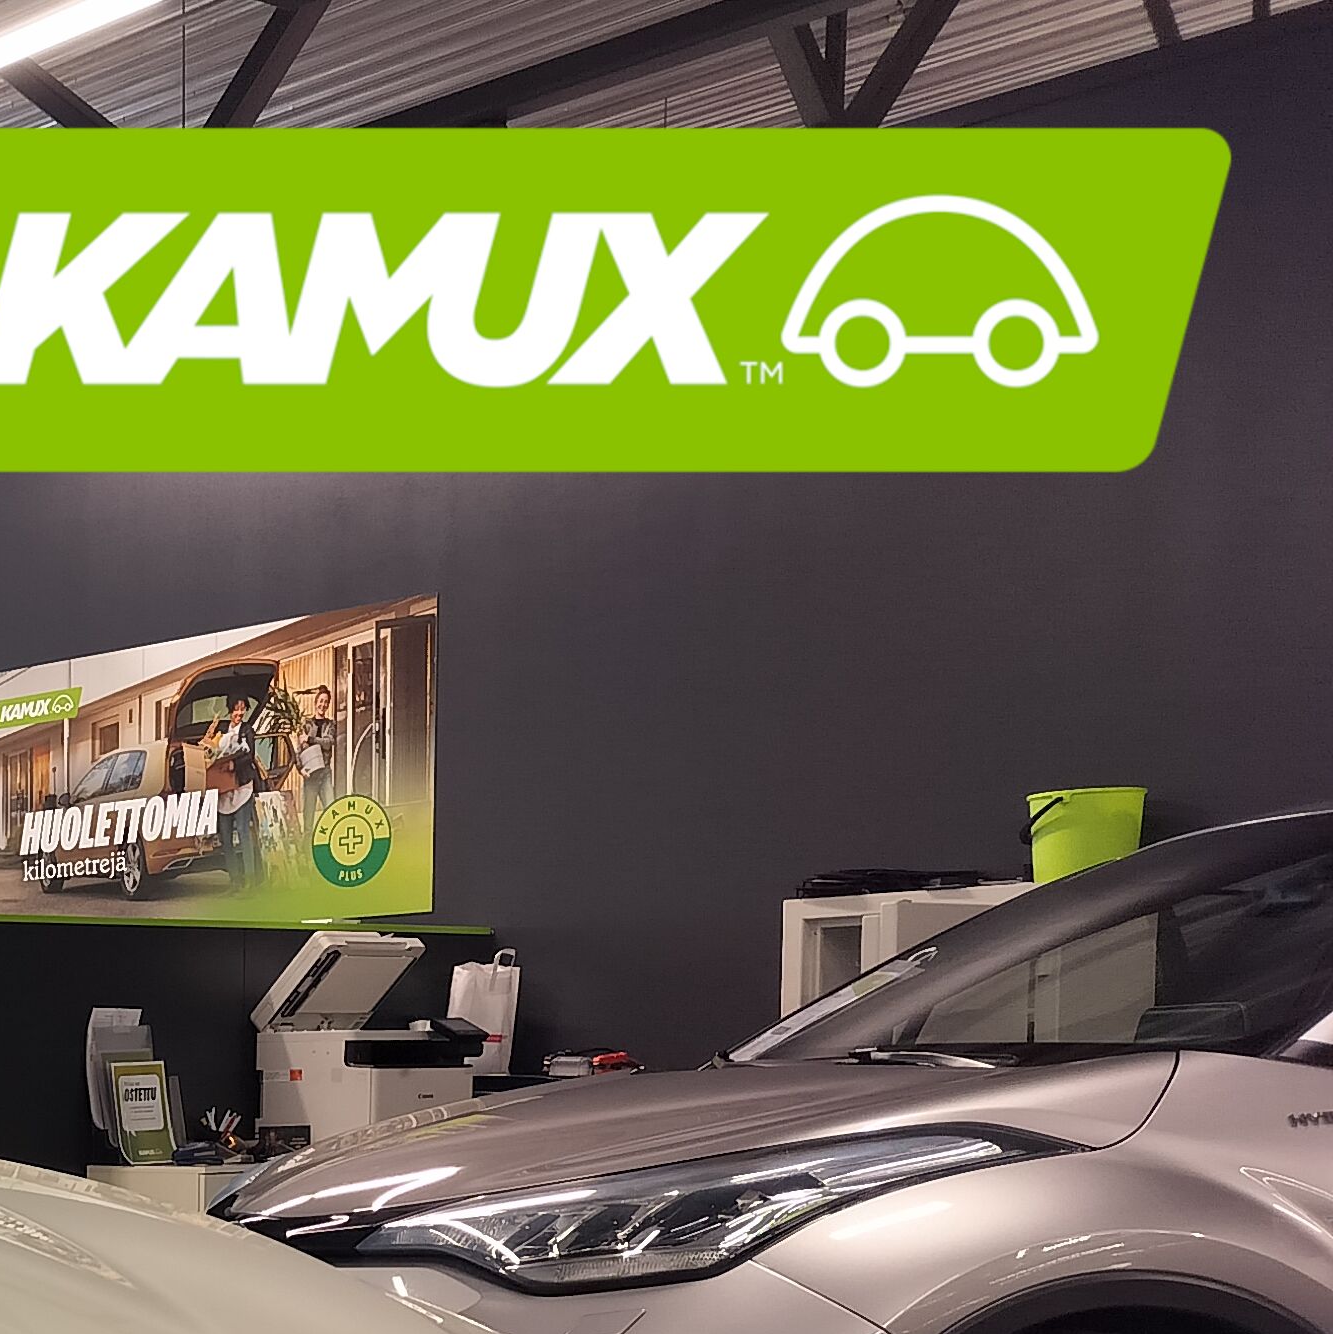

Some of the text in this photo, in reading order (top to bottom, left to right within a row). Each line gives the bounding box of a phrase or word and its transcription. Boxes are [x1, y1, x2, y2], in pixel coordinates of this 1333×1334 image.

[0, 698, 52, 723] KAMUX
[20, 788, 219, 856] HUOLETTOMIA
[319, 801, 384, 835] KAMUX
[23, 851, 128, 882] kilometrejä
[338, 868, 363, 882] PLUS
[124, 1086, 157, 1102] OSTETTU
